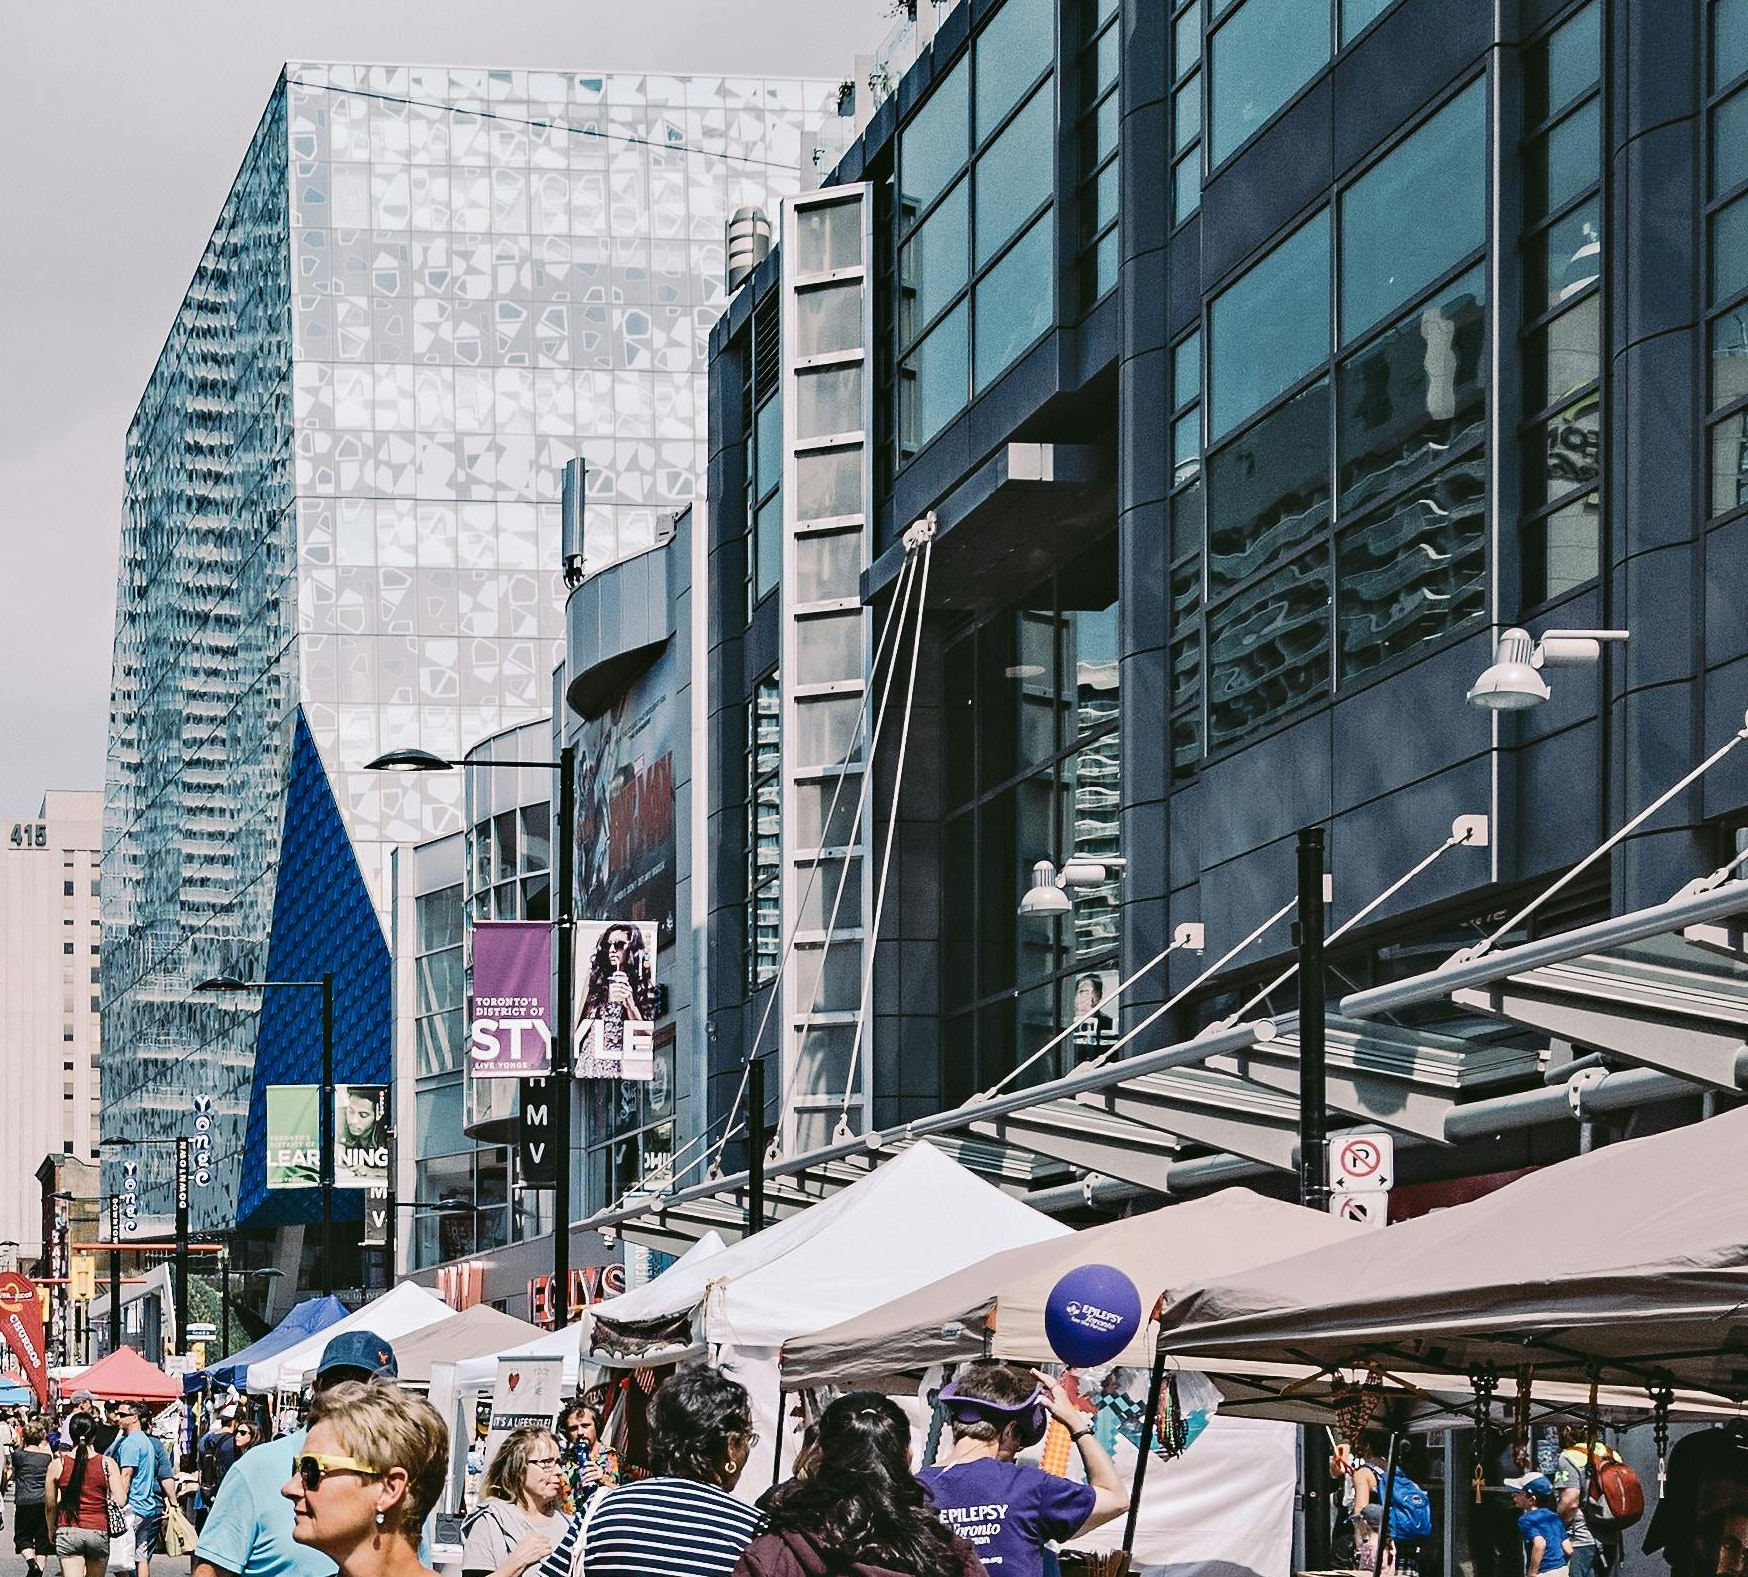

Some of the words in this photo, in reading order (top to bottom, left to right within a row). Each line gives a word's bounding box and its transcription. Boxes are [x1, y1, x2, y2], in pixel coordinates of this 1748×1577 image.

[11, 824, 46, 847] 415
[476, 997, 538, 1006] TORONTO'S
[476, 1007, 527, 1016] DISTRICT
[530, 1007, 545, 1016] OF
[179, 1141, 187, 1209] DOWNTOWN
[1082, 1304, 1123, 1324] EPILEPSY
[1085, 1313, 1115, 1330] Toronto
[10, 1314, 41, 1369] CHURROS
[939, 1504, 1009, 1524] EPILEPSY
